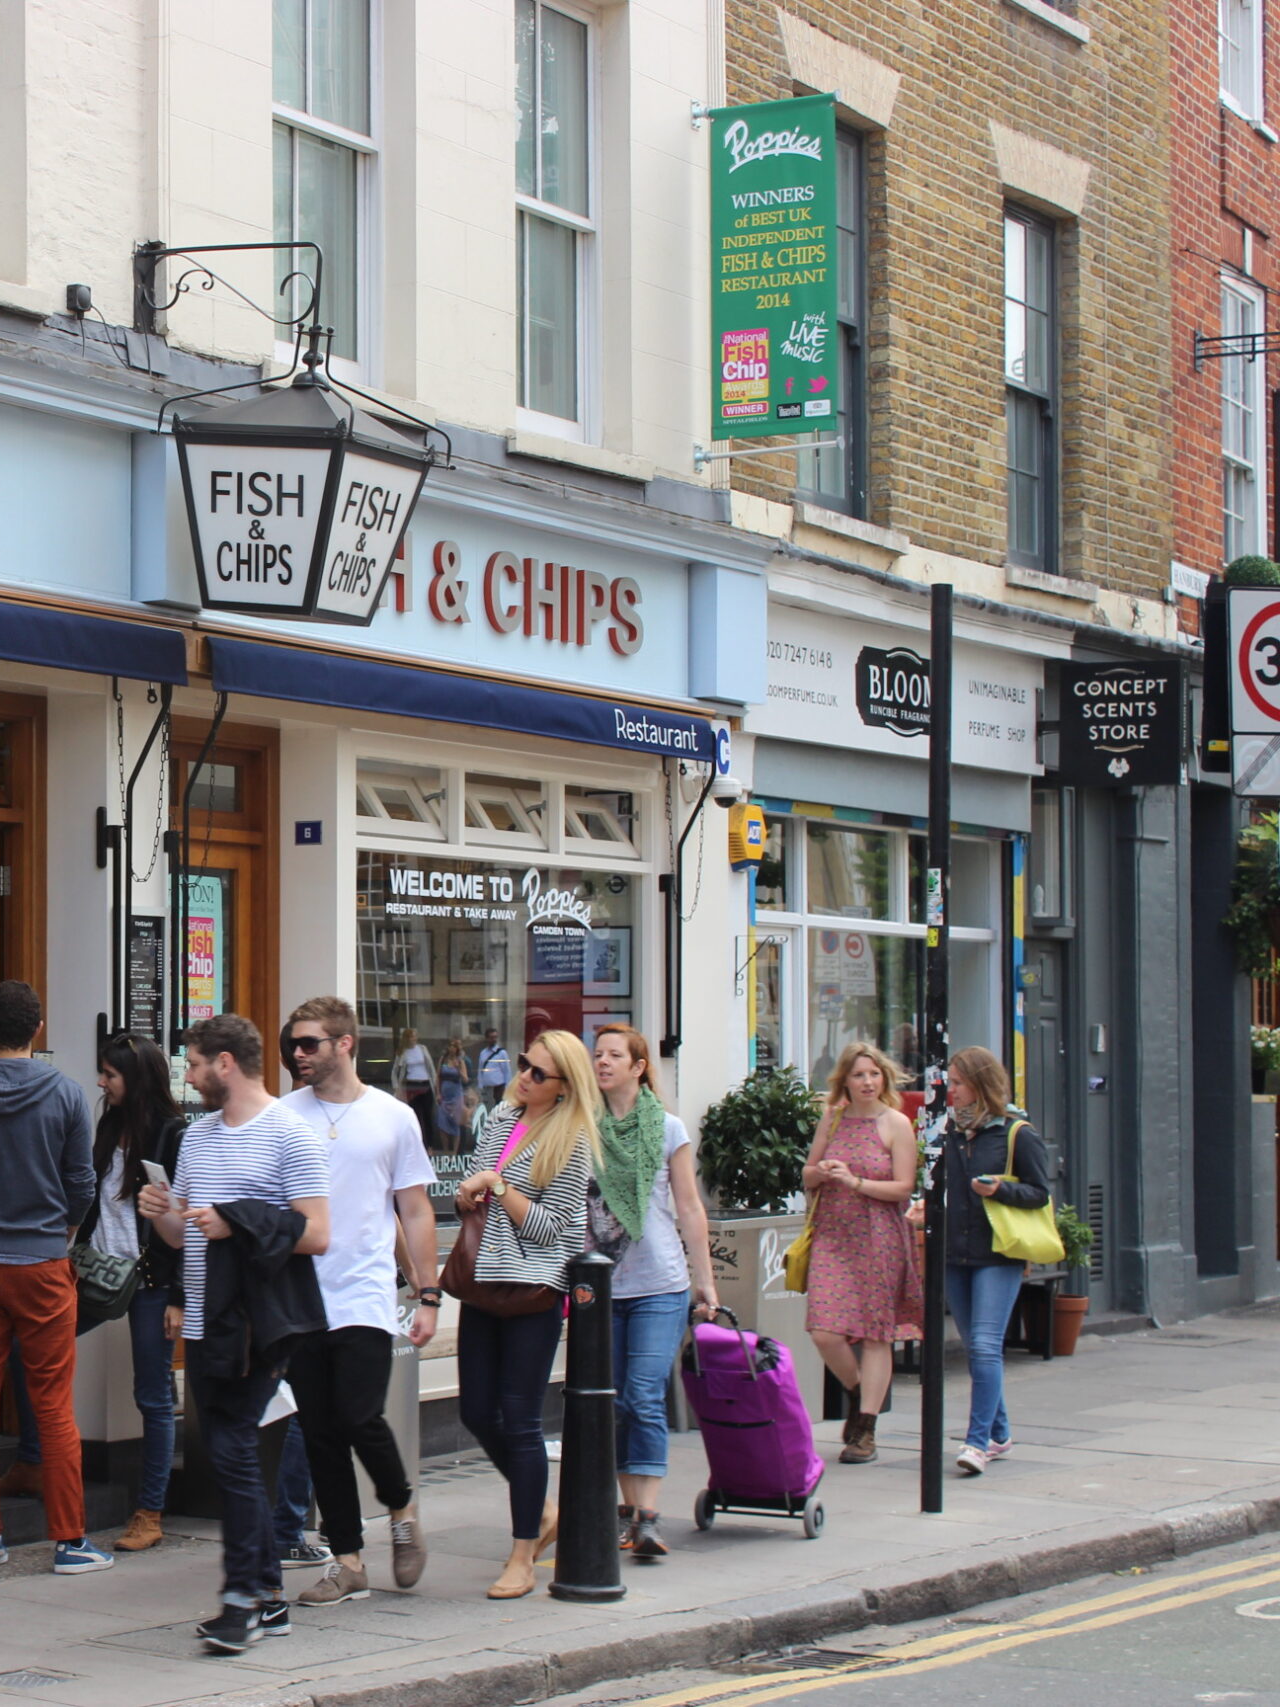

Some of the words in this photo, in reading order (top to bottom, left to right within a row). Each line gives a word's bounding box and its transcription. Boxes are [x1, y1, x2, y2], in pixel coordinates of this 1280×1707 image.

[724, 120, 822, 174] Poppies
[732, 185, 815, 209] WINNERS
[735, 215, 749, 228] of
[751, 210, 786, 227] BEST
[789, 207, 812, 221] UK
[722, 226, 825, 249] INDEPENDENT
[721, 252, 757, 273] FISH
[761, 251, 774, 269] &
[777, 245, 826, 267] CHIPS
[721, 268, 826, 292] RESTAURANT
[756, 293, 790, 309] 2014
[803, 311, 826, 325] with
[728, 331, 767, 344] National
[789, 320, 829, 346] LIVE
[724, 340, 767, 362] Fish
[722, 360, 767, 380] Chip
[725, 404, 763, 415] WINNER
[210, 470, 304, 517] FISH
[341, 481, 402, 534] FISH
[248, 519, 265, 540] &
[355, 532, 367, 552] &
[216, 541, 293, 585] CHIPS
[328, 551, 376, 597] CHIPS
[429, 540, 472, 624] &
[483, 551, 644, 655] CHIPS
[784, 643, 807, 664] 7247
[809, 651, 833, 669] 6148
[1255, 636, 1280, 686] 3
[969, 680, 1026, 705] UNIMAGINABLE
[1073, 678, 1168, 697] CONCEPT
[870, 704, 898, 719] RUNCIBLE
[1082, 702, 1157, 718] SCENTS
[615, 709, 699, 752] Restaurant
[969, 721, 1000, 739] PERFUME
[1008, 727, 1026, 742] SHOP
[1088, 724, 1150, 740] STORE
[303, 827, 312, 839] 6
[188, 885, 214, 904] ON!
[389, 868, 484, 900] WELCOME
[489, 876, 514, 902] TO
[522, 867, 592, 931] Poppies
[386, 902, 452, 918] RESTAURANT
[454, 907, 461, 918] &
[463, 907, 488, 919] TAKE
[490, 909, 517, 921] AWAY
[188, 921, 213, 932] ational
[533, 925, 563, 935] CAMDEN
[564, 927, 585, 936] TOWN
[188, 931, 213, 953] ish
[189, 1007, 211, 1017] NALIST
[431, 1154, 472, 1173] AURANT
